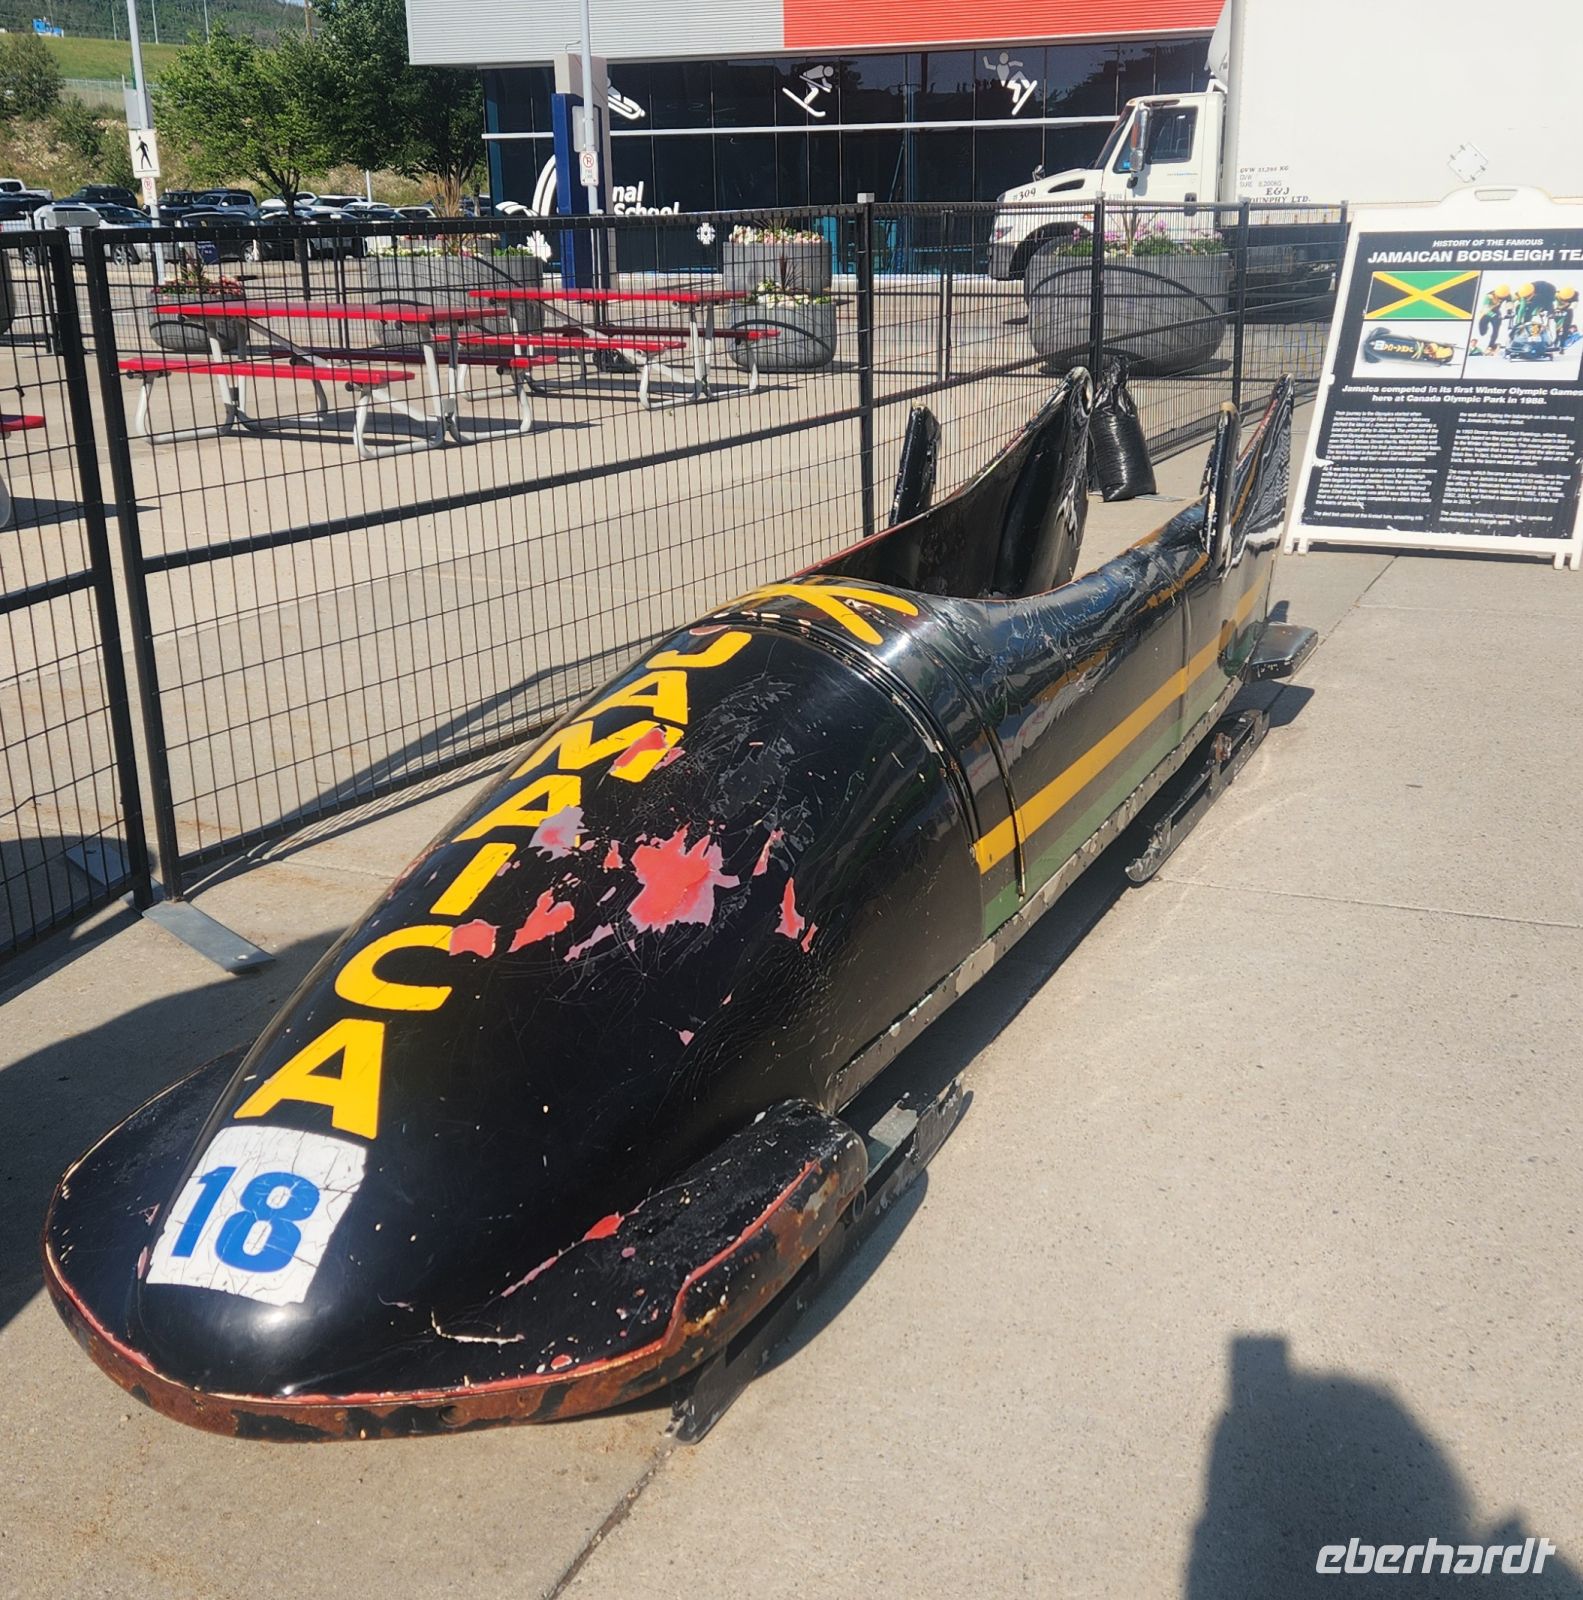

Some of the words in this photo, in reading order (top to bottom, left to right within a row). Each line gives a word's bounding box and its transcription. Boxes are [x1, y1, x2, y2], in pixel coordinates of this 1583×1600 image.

[1266, 187, 1290, 196] E&J
[1473, 239, 1485, 247] OF
[1368, 251, 1452, 263] JAMAICAN
[1456, 250, 1553, 262] BOBSLEIGH
[1559, 250, 1583, 260] TE
[1342, 385, 1379, 394] Jamaica
[1381, 386, 1427, 394] competed
[1429, 386, 1437, 395] in
[1440, 386, 1452, 395] its
[1454, 387, 1473, 395] first
[1475, 387, 1507, 395] Winter
[1509, 387, 1548, 395] Olympic
[1372, 394, 1392, 402] here
[1407, 395, 1441, 403] Canada
[1483, 396, 1505, 404] Park
[1508, 396, 1517, 404] in
[233, 630, 753, 1140] JAMAICA
[168, 1165, 321, 1274] 18
